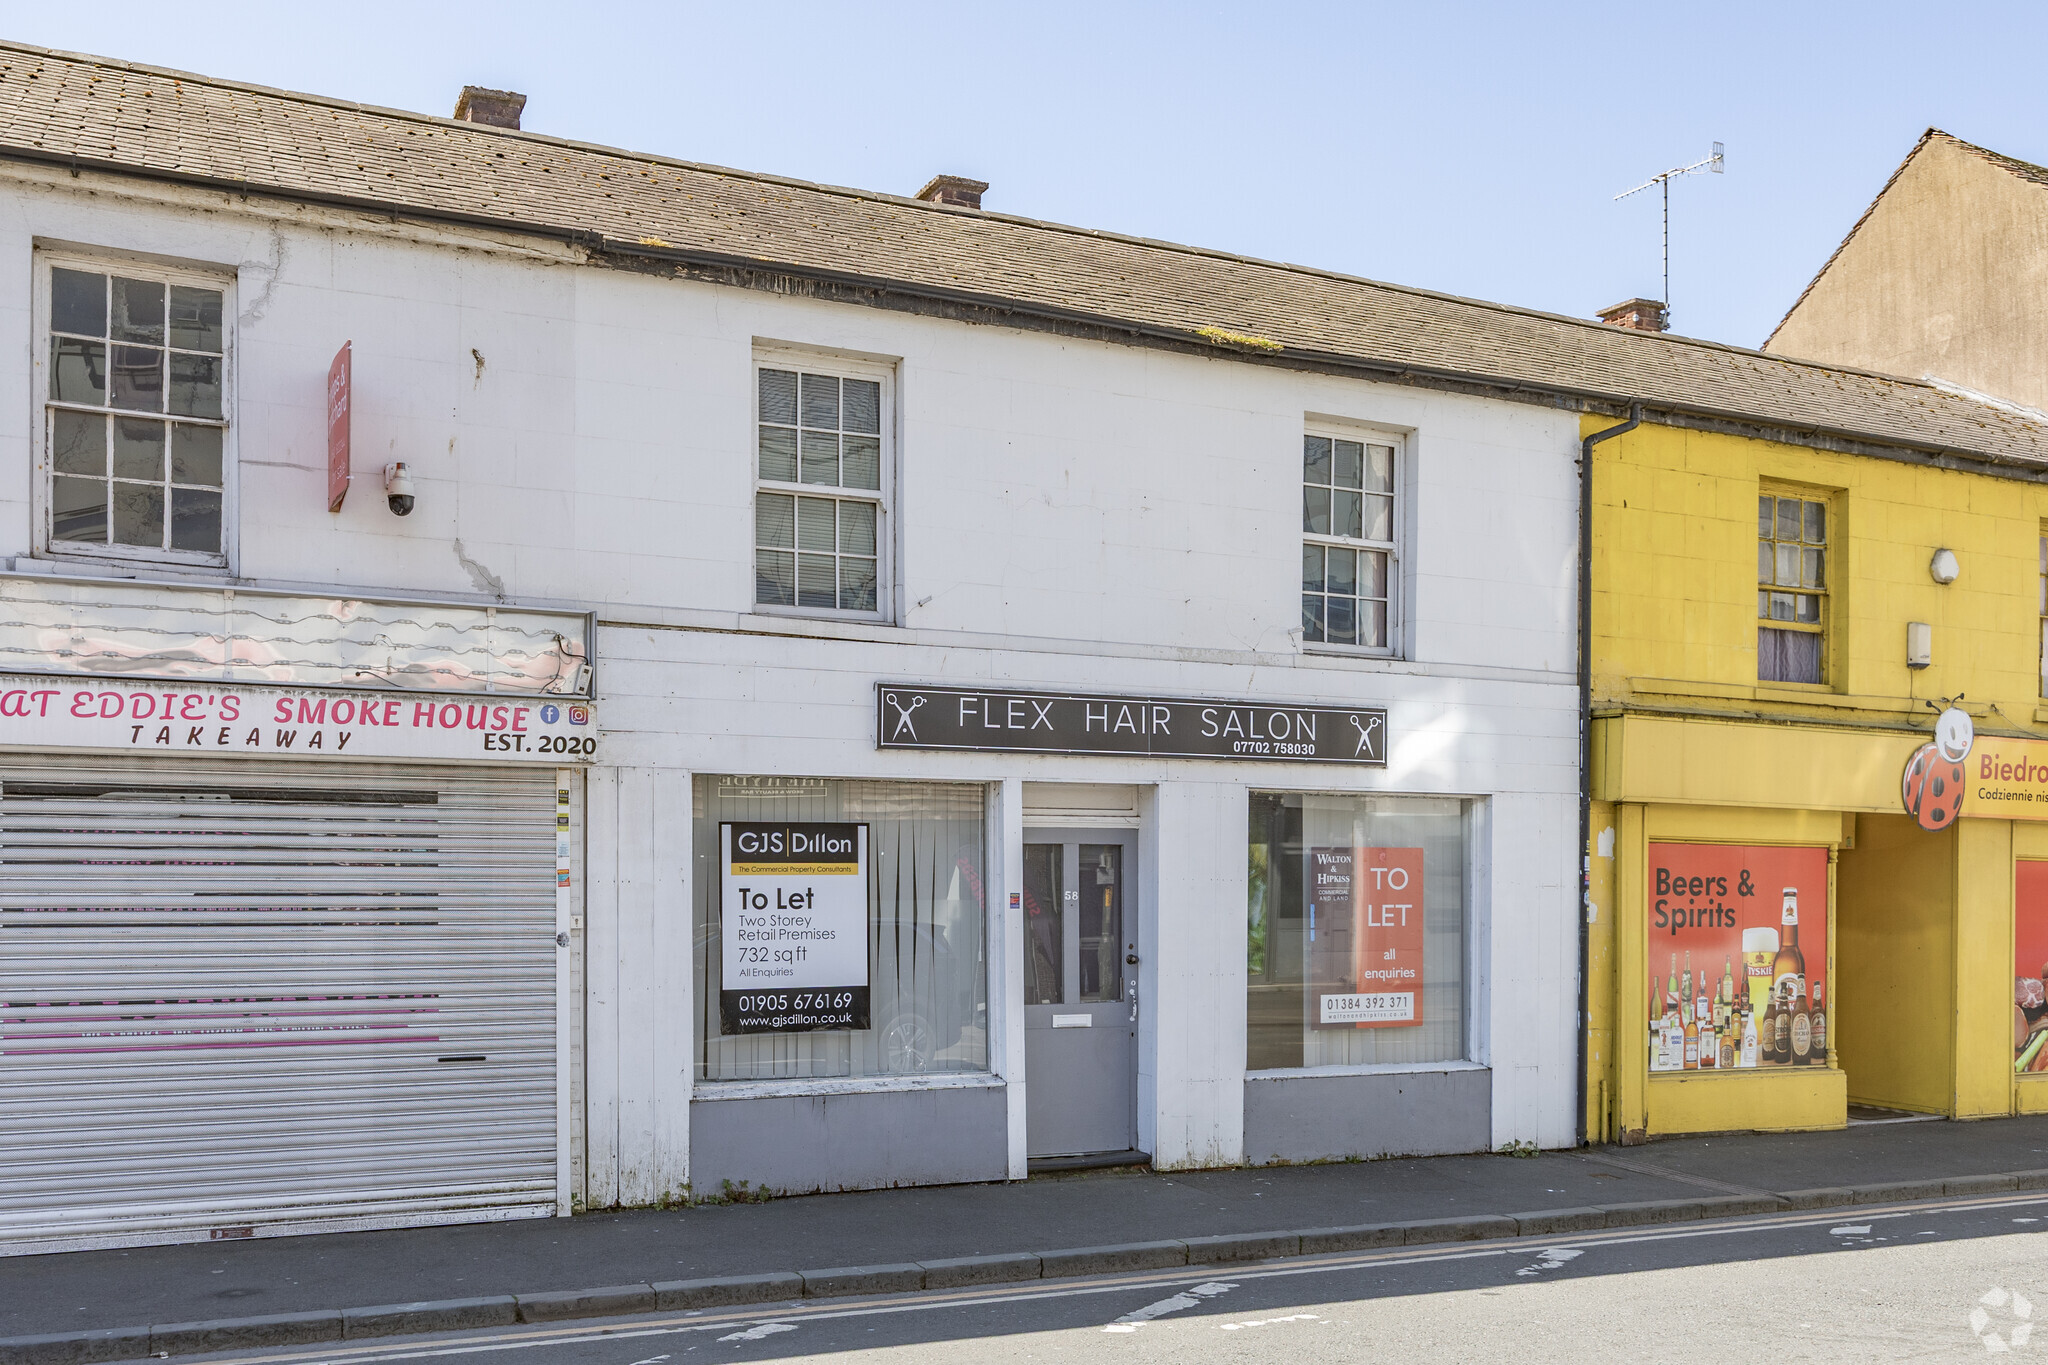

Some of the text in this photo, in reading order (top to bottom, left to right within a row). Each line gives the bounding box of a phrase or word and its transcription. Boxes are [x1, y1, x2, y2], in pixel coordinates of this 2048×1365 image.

[0, 689, 530, 731] AT EDDIE'S SMOKE HOUSE
[959, 697, 1316, 741] FLEX HAIR SALON
[131, 725, 352, 750] TAKEAWAY
[484, 732, 597, 755] EST. 2020
[1233, 741, 1315, 755] 07702 758030
[1980, 753, 2048, 783] Biedro
[1978, 787, 2033, 801] Codziennie
[738, 831, 852, 853] GJS Dillon
[1316, 853, 1351, 865] WALTON
[790, 866, 815, 874] Property
[1330, 864, 1337, 873] &
[1317, 873, 1350, 884] HIPKISS
[1370, 867, 1409, 890] TO
[1655, 868, 1755, 897] Beers &
[738, 887, 814, 910] To Let
[1064, 891, 1078, 901] 58
[739, 914, 812, 928] Two Storey
[1368, 904, 1412, 927] LET
[1654, 899, 1736, 935] Spirits
[738, 927, 836, 941] Retail Premises
[739, 945, 808, 965] 732 sq ft
[1383, 948, 1396, 961] all
[739, 967, 794, 978] All Enquiries
[1364, 967, 1416, 982] enquiries
[1747, 966, 1773, 976] TYSKIE
[739, 992, 852, 1012] 01905 676169
[1327, 997, 1407, 1010] 01384 392 371
[739, 1012, 853, 1028] www.gjsdillon.co.uk
